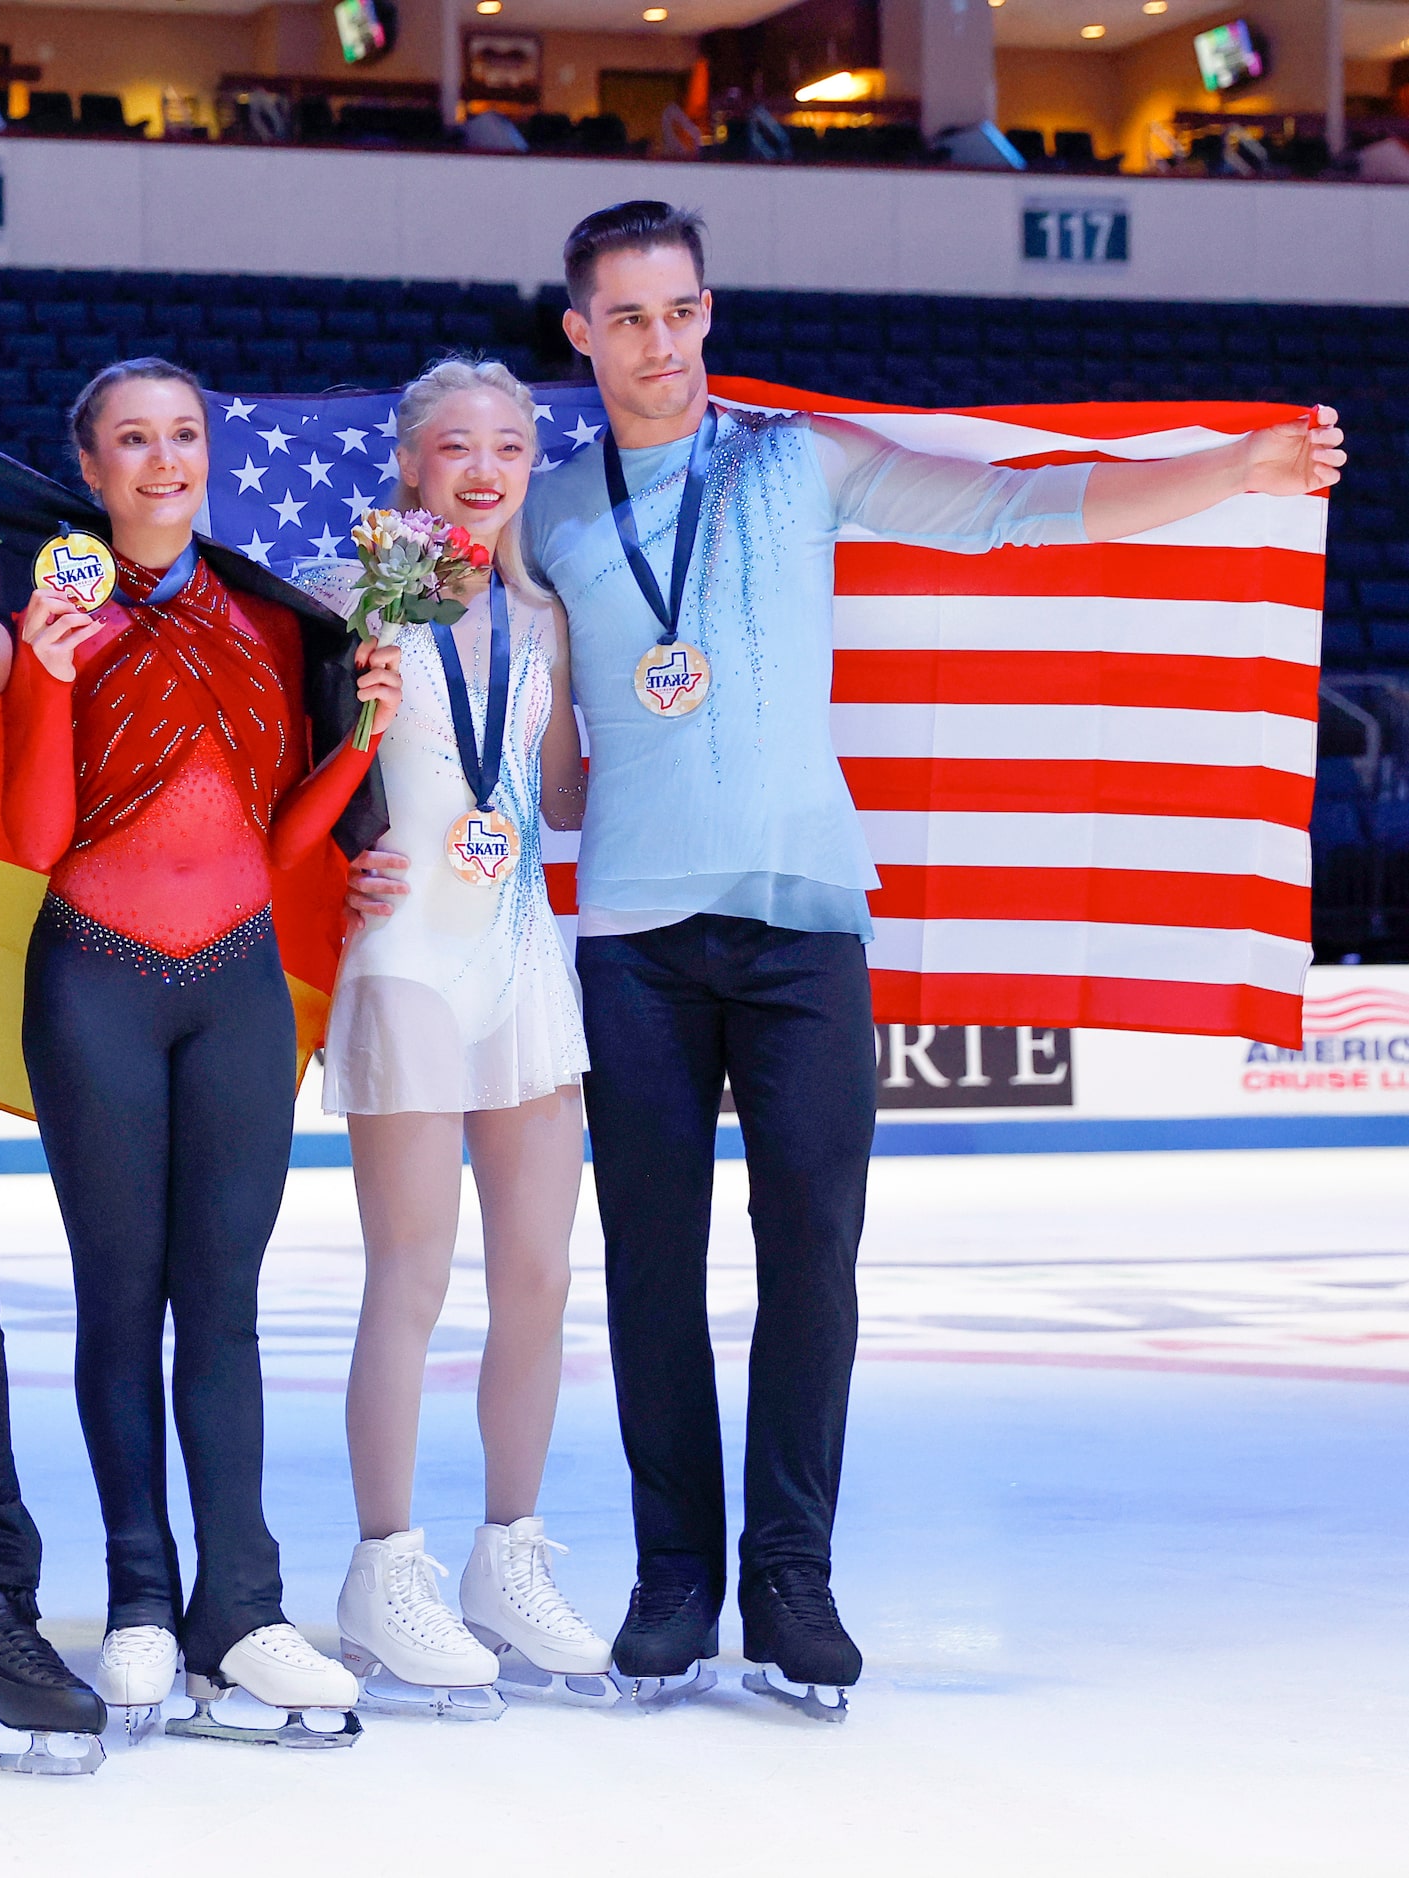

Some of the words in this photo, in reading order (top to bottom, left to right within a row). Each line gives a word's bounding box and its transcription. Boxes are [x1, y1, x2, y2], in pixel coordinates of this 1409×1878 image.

[1039, 213, 1112, 260] 117
[57, 564, 104, 585] SKATE
[467, 842, 509, 856] SKATE
[876, 1024, 1068, 1088] RTE
[1243, 1071, 1369, 1090] CRUISE
